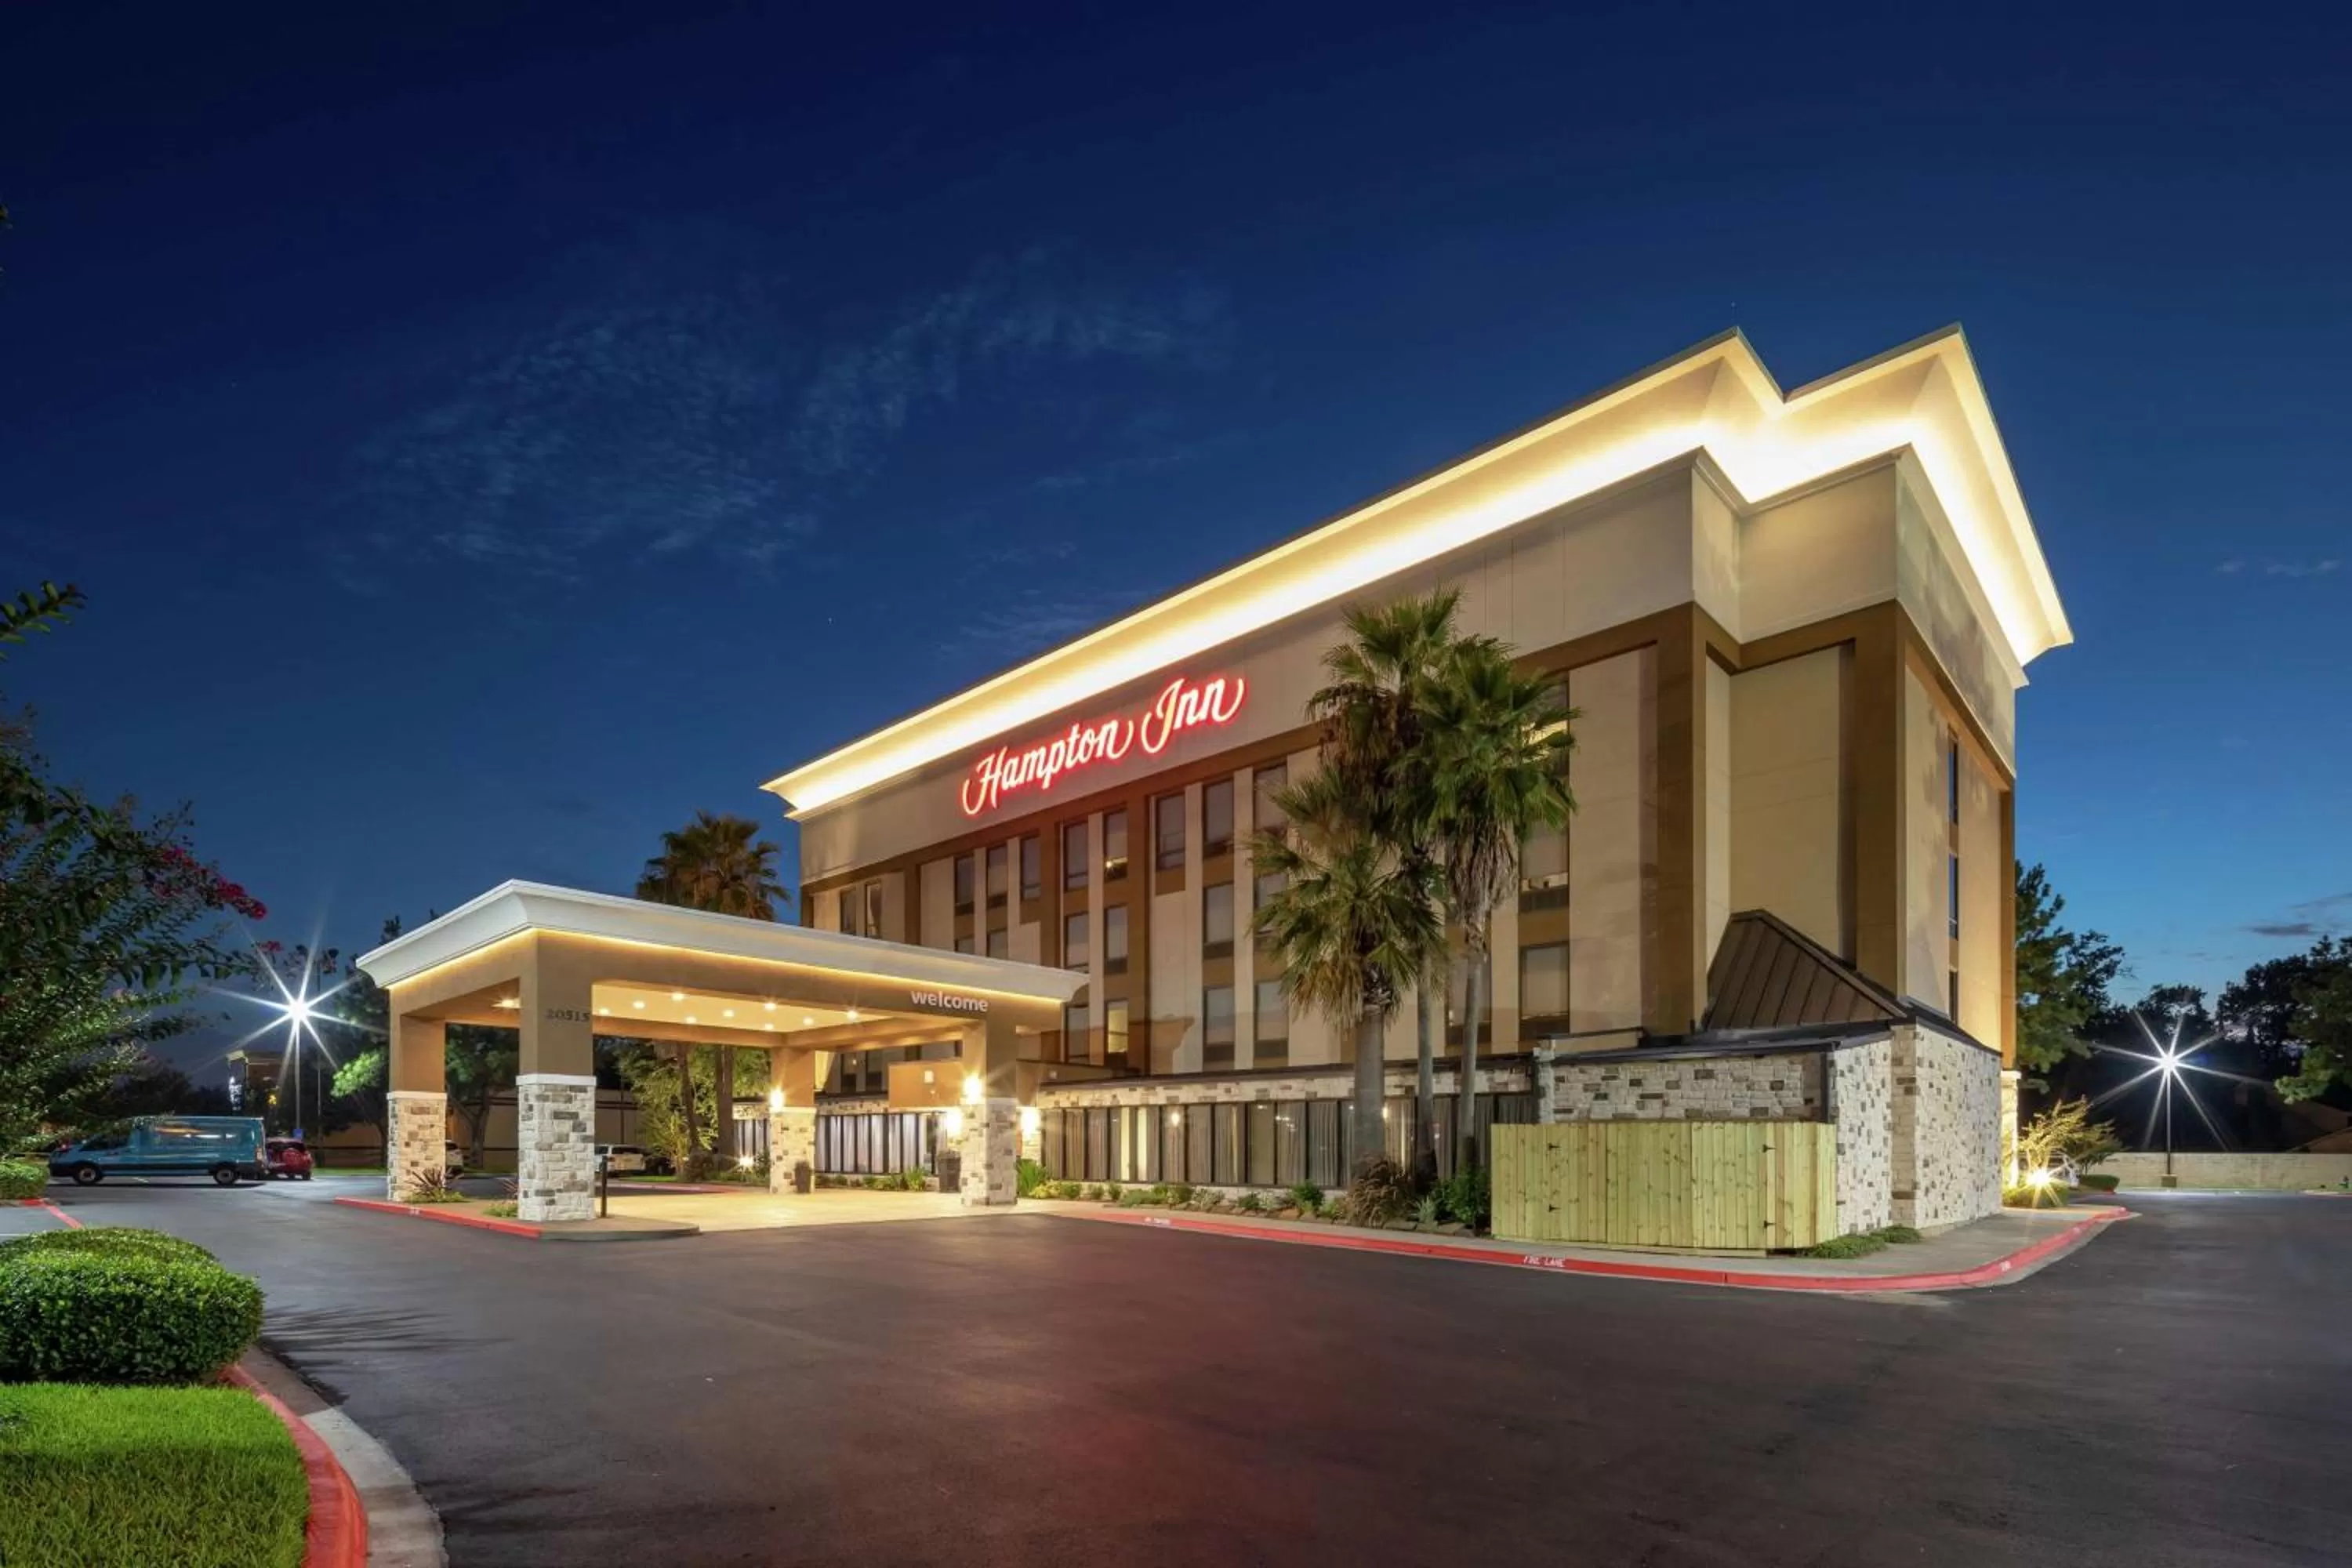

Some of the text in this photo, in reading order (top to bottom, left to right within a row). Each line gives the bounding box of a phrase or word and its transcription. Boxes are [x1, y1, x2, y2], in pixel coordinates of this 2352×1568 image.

[962, 677, 1245, 815] Hampton Inn
[910, 990, 989, 1012] welcome
